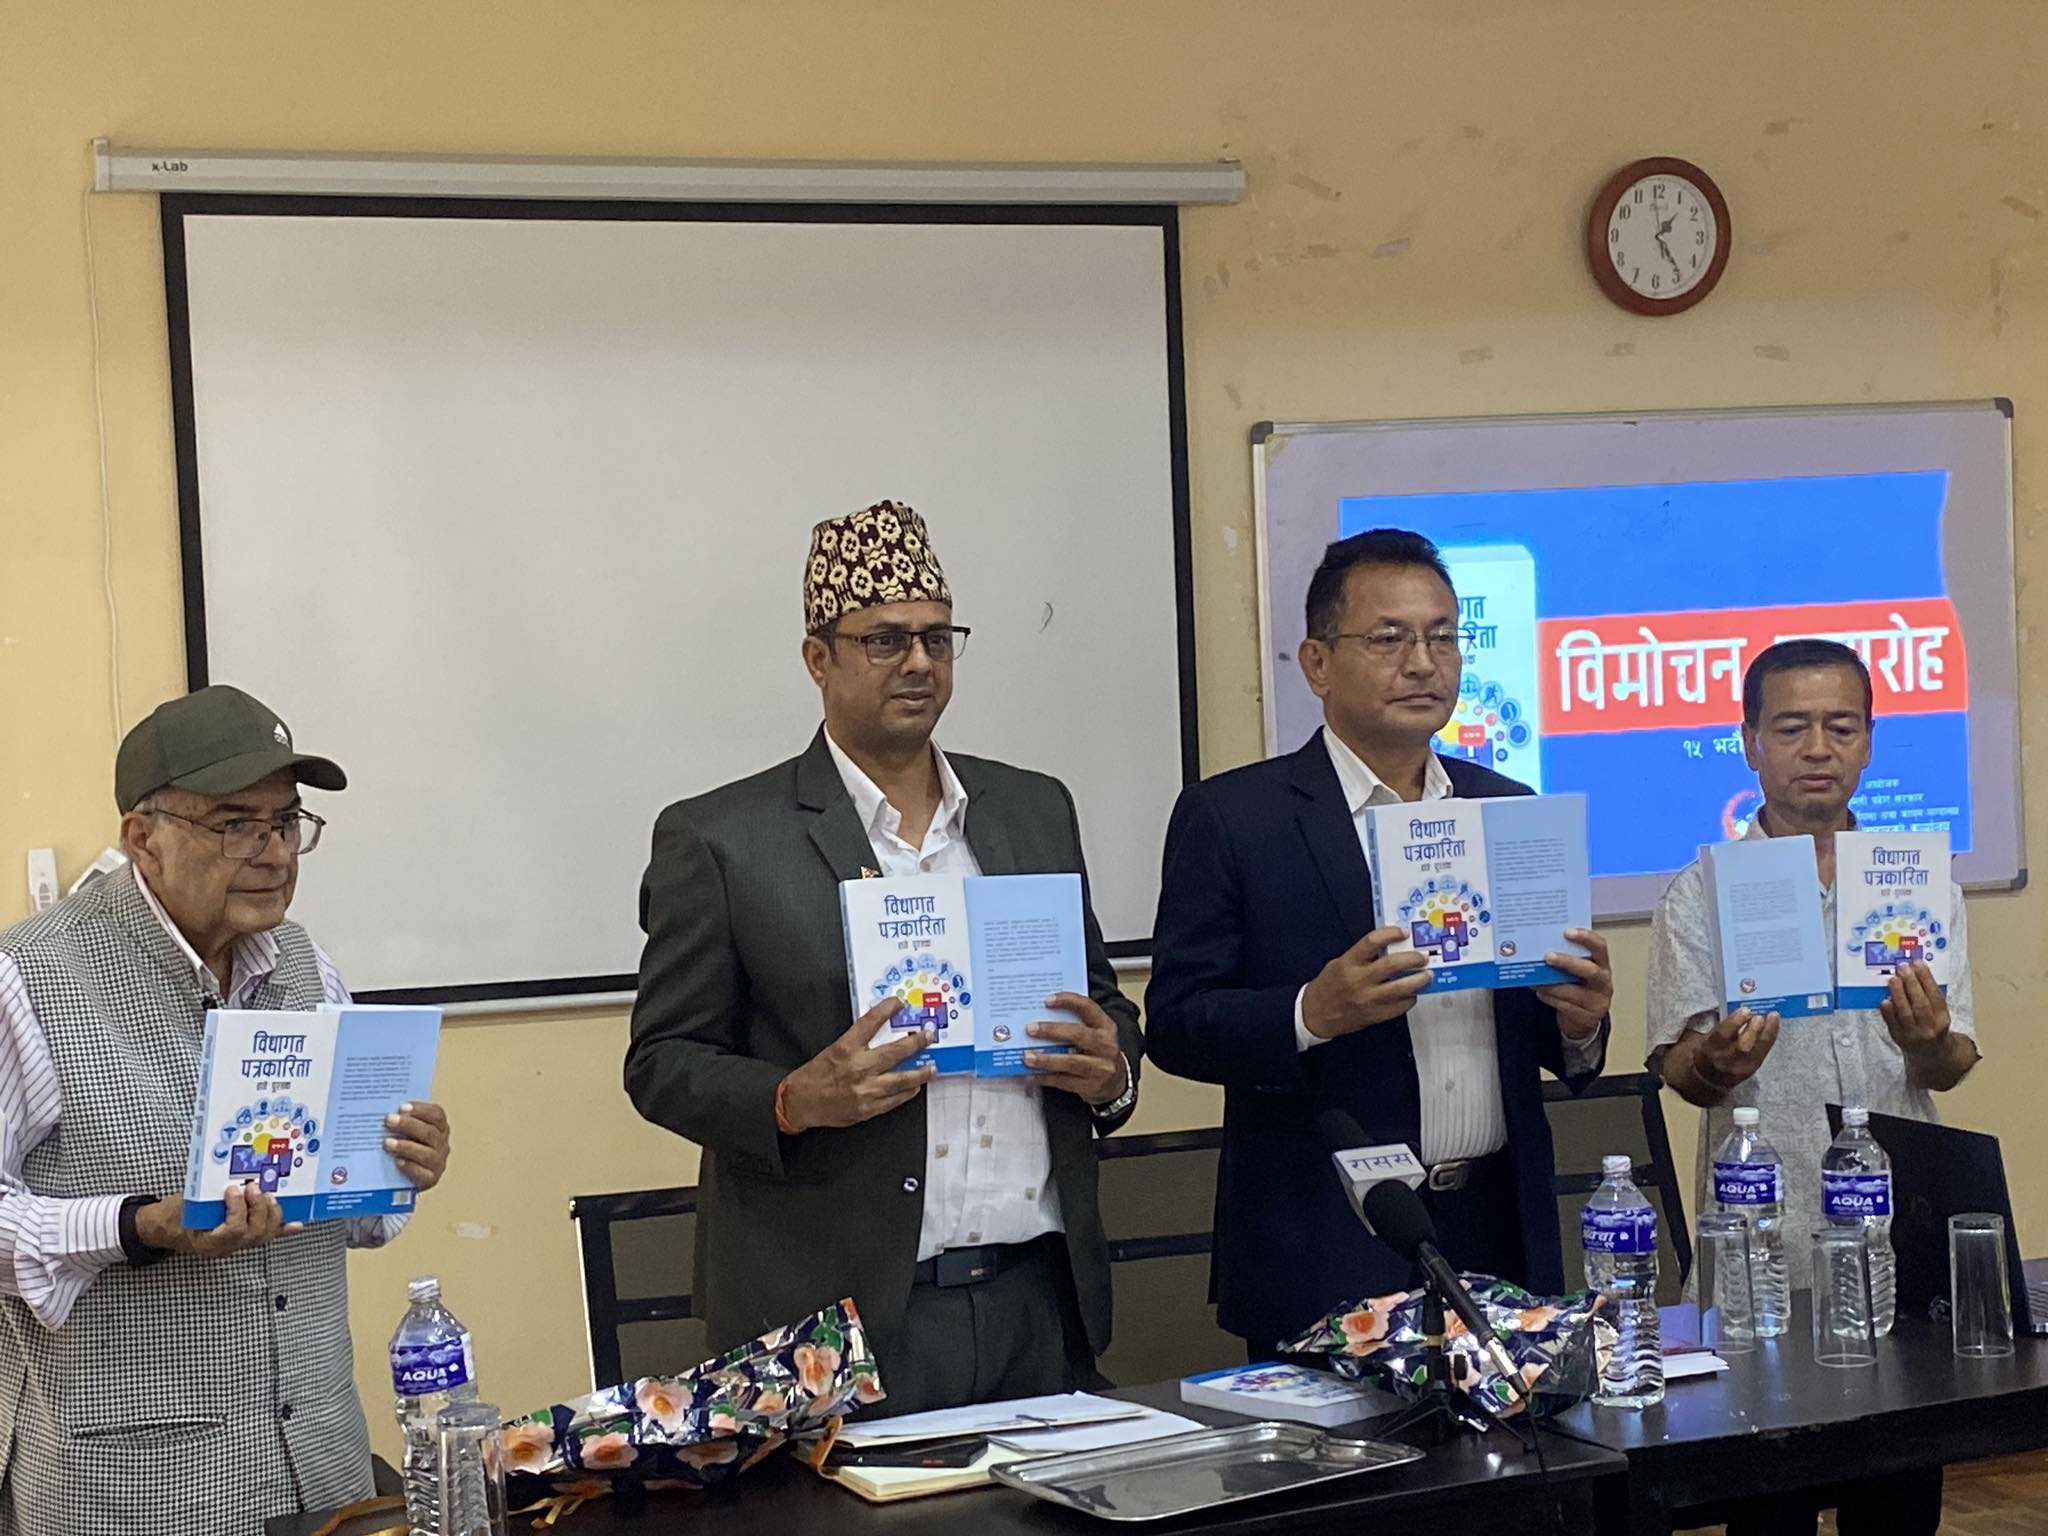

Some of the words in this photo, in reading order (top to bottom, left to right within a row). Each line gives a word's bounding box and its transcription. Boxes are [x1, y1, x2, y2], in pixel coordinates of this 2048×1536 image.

[1634, 189, 1643, 204] 11
[1653, 184, 1665, 199] 12
[1677, 191, 1682, 205] 1
[1619, 204, 1631, 220] 10
[1690, 207, 1698, 222] 2
[1610, 228, 1619, 243] 9
[1696, 231, 1705, 245] 3
[1616, 251, 1625, 267] 8
[1688, 253, 1696, 268] 4
[1632, 268, 1640, 284] 7
[1651, 274, 1660, 289] 6
[1672, 268, 1681, 284] 5
[1555, 628, 1747, 712] विमोचन
[1403, 837, 1466, 862] पत्रकारिता
[1864, 866, 1930, 886] पत्रकारिता
[878, 915, 946, 938] पत्रकारिता
[241, 1054, 312, 1078] पत्रकारिता
[1345, 1153, 1413, 1171] रासस
[1719, 1183, 1756, 1194] AQUA
[1831, 1196, 1873, 1207] AQUA
[402, 1367, 447, 1382] AQUA
